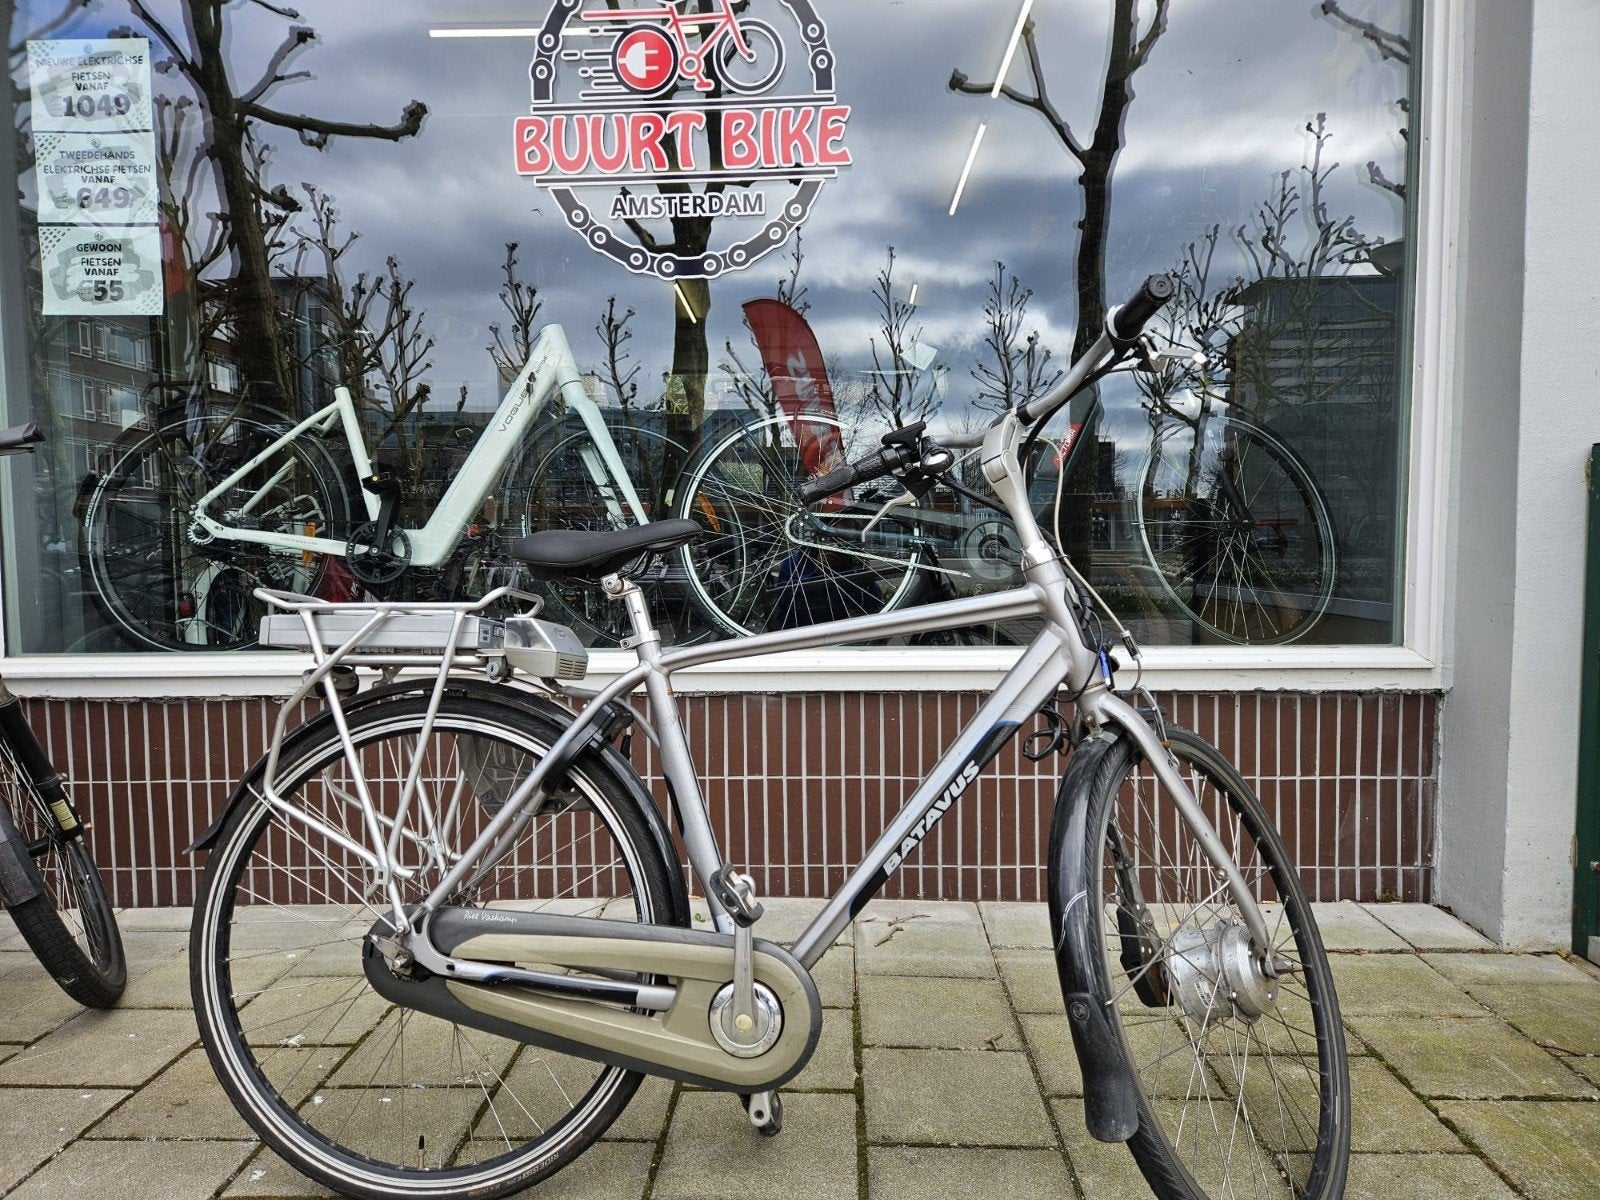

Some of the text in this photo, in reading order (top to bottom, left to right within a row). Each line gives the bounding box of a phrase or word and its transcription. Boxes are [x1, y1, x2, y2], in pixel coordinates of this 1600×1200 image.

[71, 71, 112, 81] FIETSEN
[75, 82, 109, 92] VANAF
[513, 105, 853, 176] BUURT BIKE
[59, 150, 136, 160] TWEEDEHANDS
[112, 164, 152, 174] FIETSEN
[81, 175, 116, 184] VANAF
[611, 191, 767, 220] AMSTERDAM
[76, 243, 122, 253] GEWOON
[81, 257, 122, 267] FIETSEN
[84, 268, 120, 277] VANAF
[498, 388, 529, 432] VOGUE
[882, 759, 981, 877] BATAVUS
